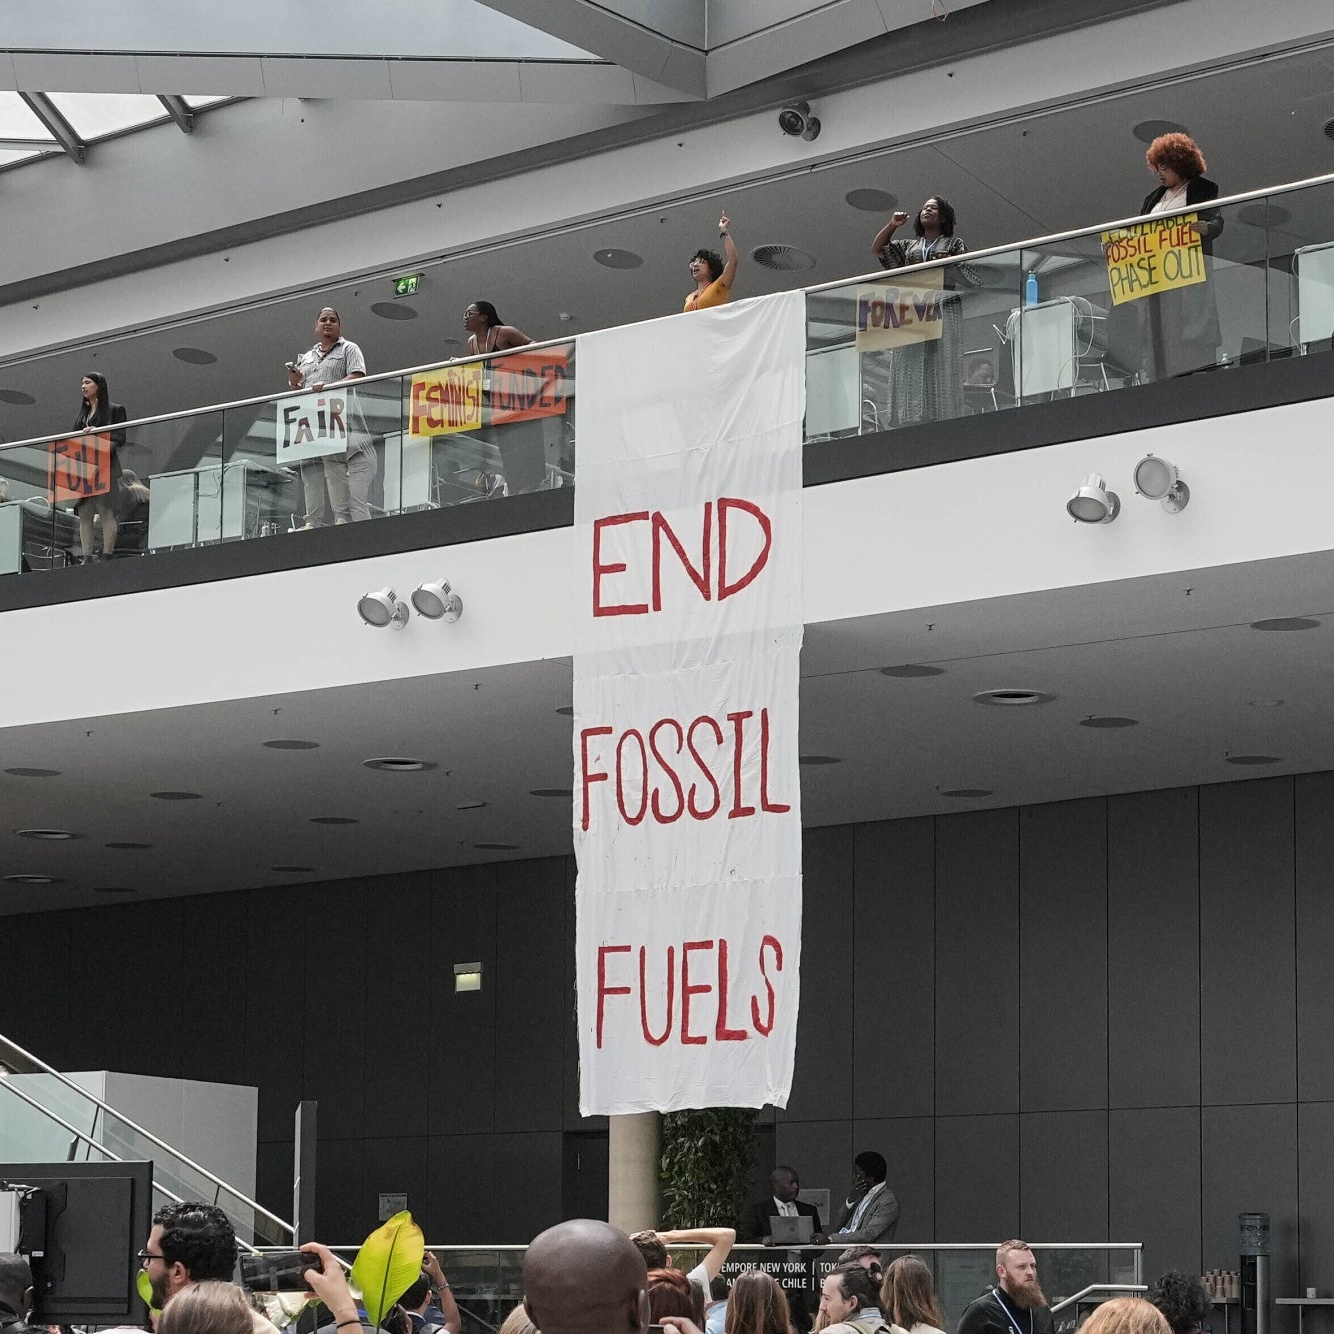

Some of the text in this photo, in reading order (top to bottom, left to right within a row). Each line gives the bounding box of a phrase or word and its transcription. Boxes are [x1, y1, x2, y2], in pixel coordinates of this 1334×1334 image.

[1106, 223, 1200, 266] FOSSIL FUEL
[1110, 245, 1203, 299] PHASE OUT
[859, 287, 943, 331] FOREVER
[489, 363, 568, 411] FUNDED
[50, 436, 107, 494] FULL
[593, 498, 772, 617] END
[581, 709, 789, 830] FOSSIL
[597, 935, 784, 1050] FUELS
[721, 1262, 807, 1273] EMPORE NEW YORK
[782, 1278, 807, 1289] CHILE
